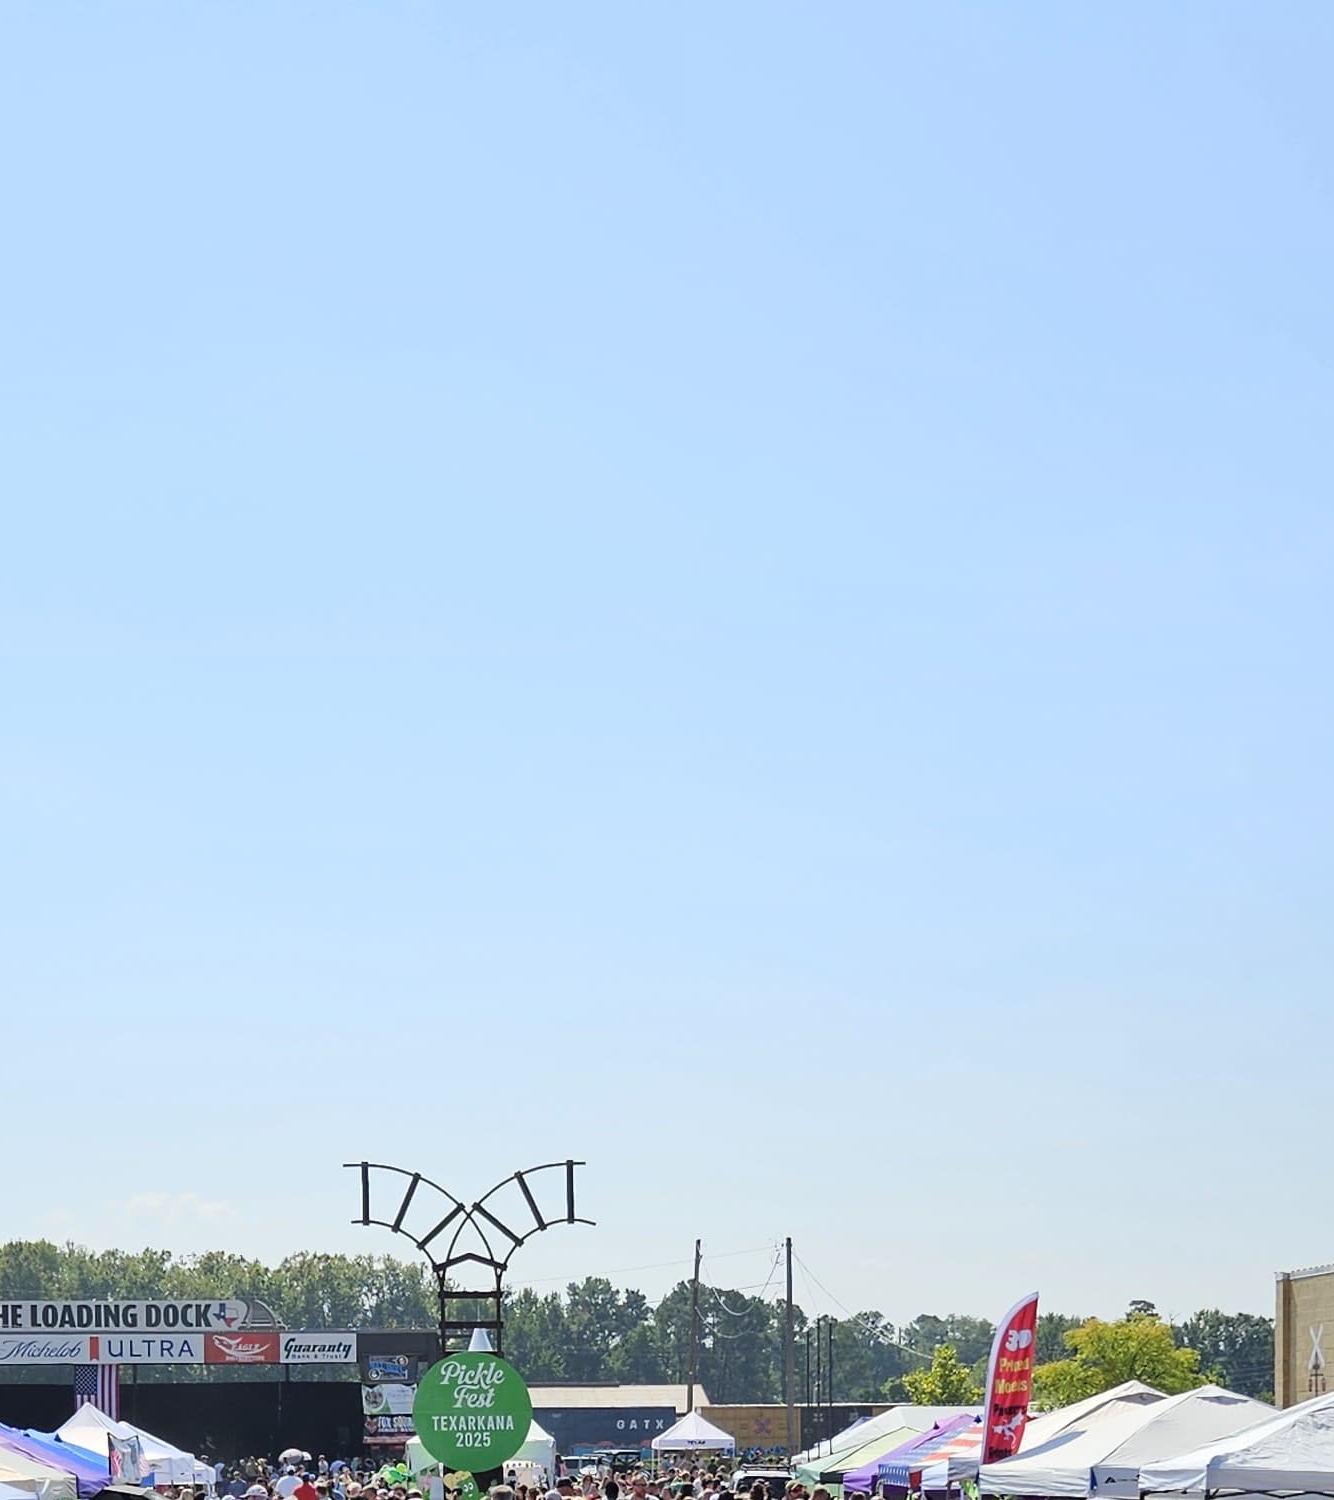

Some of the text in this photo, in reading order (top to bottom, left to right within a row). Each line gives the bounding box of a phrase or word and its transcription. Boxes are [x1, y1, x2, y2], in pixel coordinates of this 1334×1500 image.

[30, 1304, 137, 1328] LOADING
[145, 1304, 212, 1328] DOCK
[107, 1340, 194, 1357] ULTRA
[283, 1338, 352, 1359] Guaranty
[440, 1361, 505, 1389] Pickle
[452, 1385, 496, 1408] Fest
[431, 1415, 514, 1431] TEXARKANA
[617, 1419, 665, 1430] GATX
[455, 1432, 491, 1447] 2025
